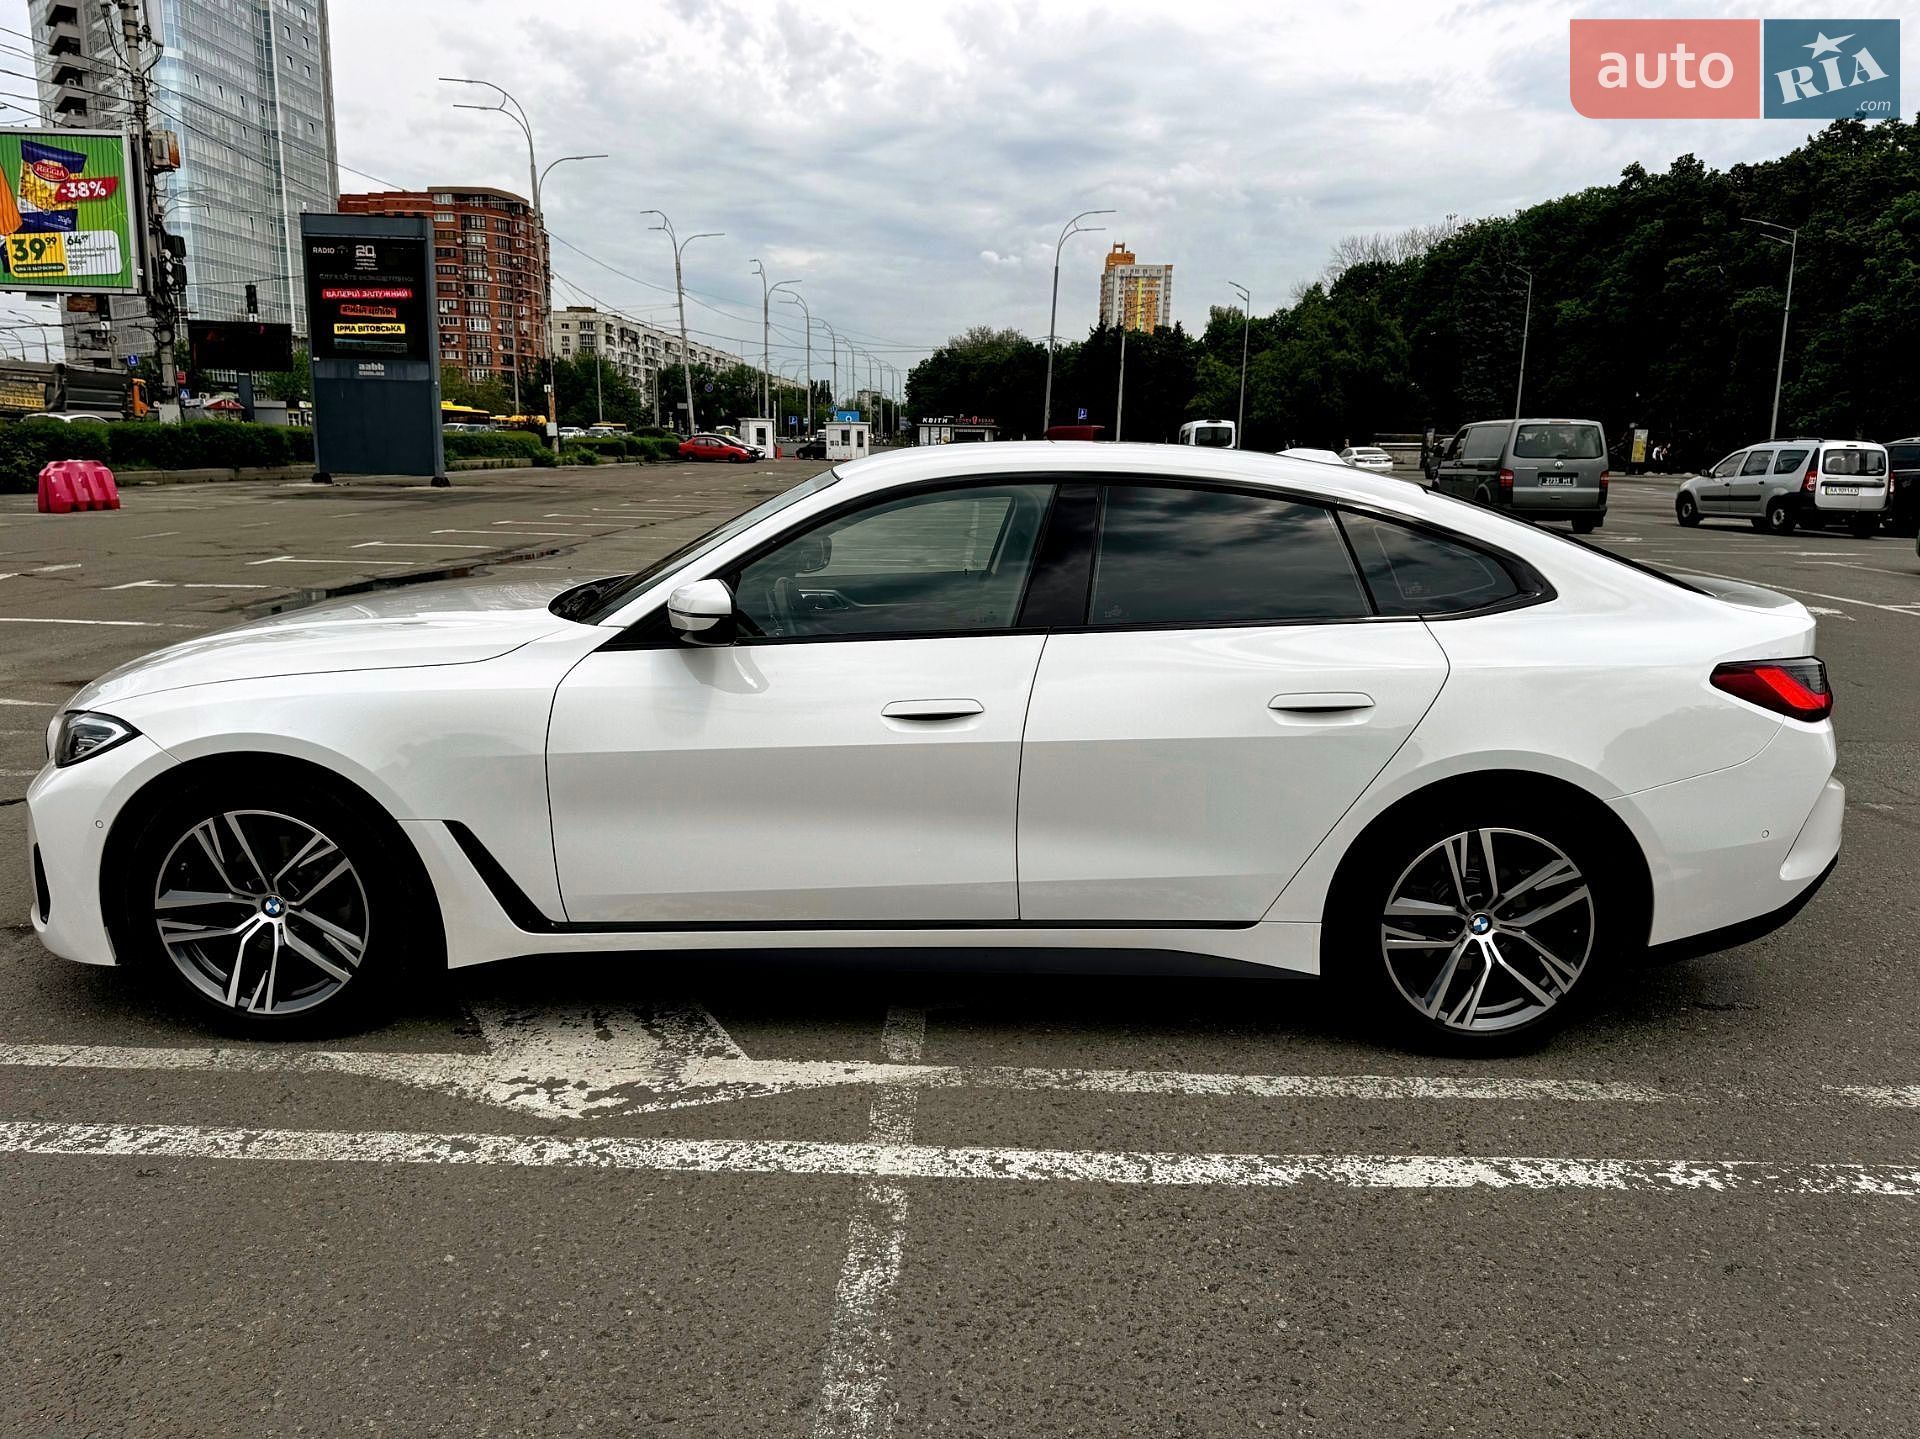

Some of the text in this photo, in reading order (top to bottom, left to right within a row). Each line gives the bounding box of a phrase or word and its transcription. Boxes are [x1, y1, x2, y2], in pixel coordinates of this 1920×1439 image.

[60, 180, 107, 198] -38%
[313, 246, 335, 254] RADIO
[362, 289, 408, 298] ЗАЛУЖНИЙ
[336, 325, 402, 333] ІРМА ВІТОВСЬКА
